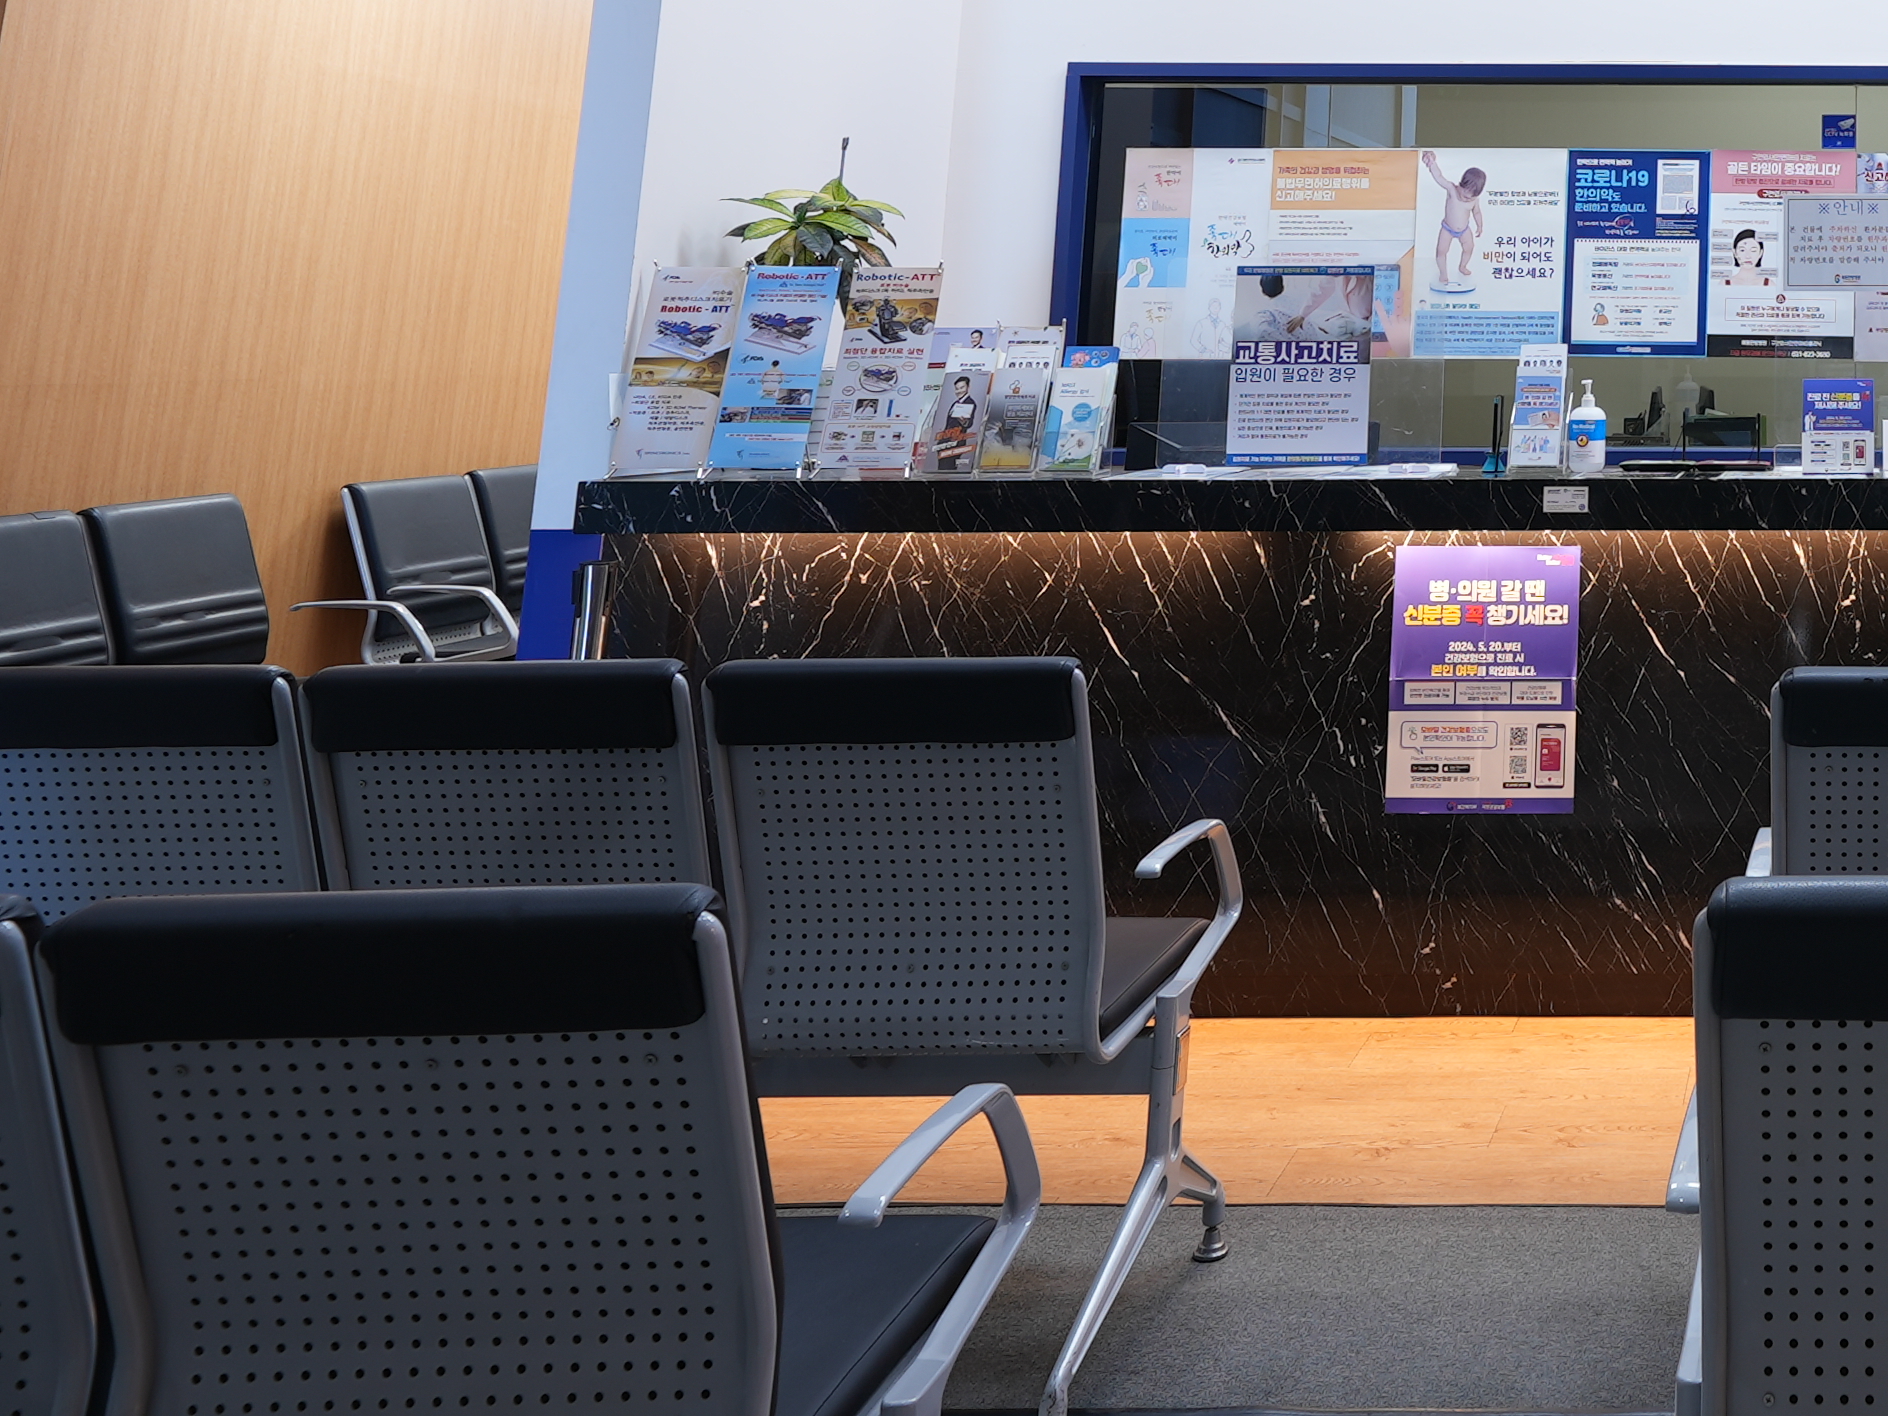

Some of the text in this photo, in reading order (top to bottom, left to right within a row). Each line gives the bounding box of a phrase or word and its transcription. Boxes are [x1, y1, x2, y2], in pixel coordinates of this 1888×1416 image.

[1727, 162, 1841, 175] 골든 타임이 중요합니다!
[1575, 169, 1649, 187] 코로나19
[1575, 189, 1622, 202] 한의약도
[1575, 203, 1608, 212] 준비하고
[1833, 199, 1863, 216] 안내
[1494, 236, 1554, 248] 우리 아이가
[1483, 252, 1554, 263] 비만이 되어도
[1492, 267, 1554, 279] 괜찮으세요?
[660, 305, 702, 313] Robotic
[1235, 341, 1358, 364] 교통사고치료
[1235, 367, 1356, 382] 입원이 필요한 경우
[1501, 580, 1523, 601] 갈
[1525, 580, 1545, 601] 땐
[1404, 605, 1569, 625] 신분증 꼭 챙기세요!
[1449, 642, 1476, 652] 2024.
[1497, 654, 1513, 662] 진료
[1515, 653, 1524, 662] 시
[1431, 665, 1453, 676] 본인
